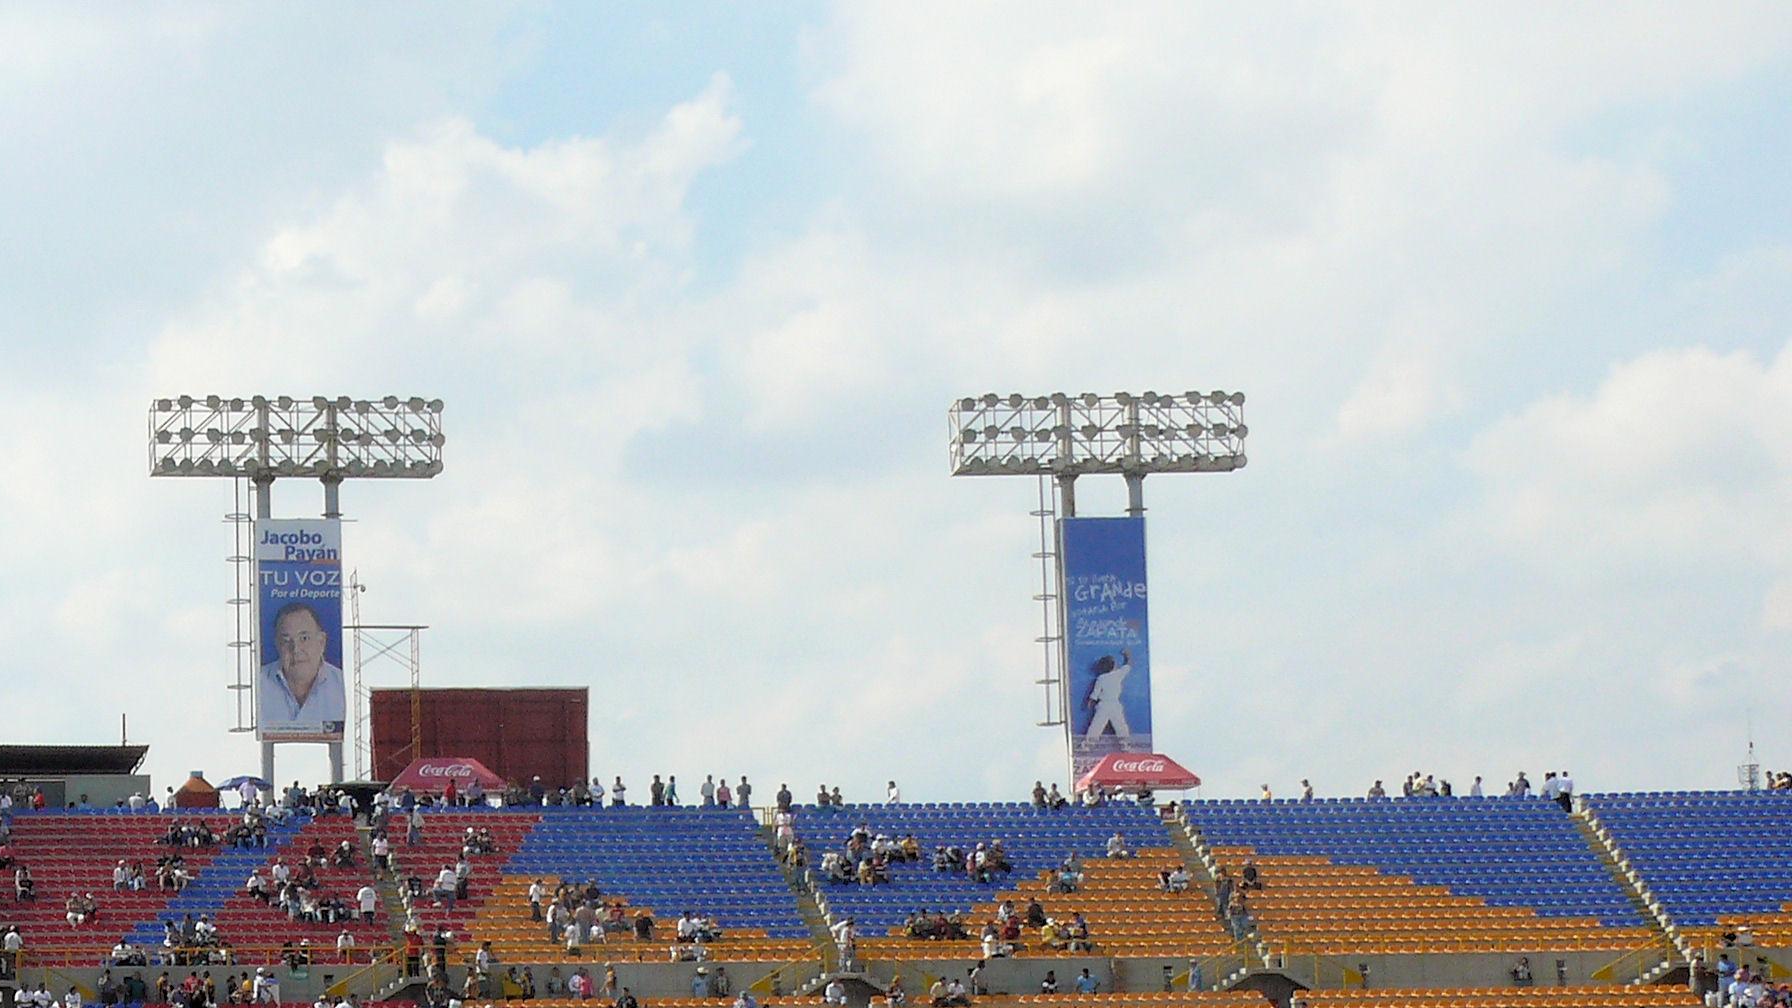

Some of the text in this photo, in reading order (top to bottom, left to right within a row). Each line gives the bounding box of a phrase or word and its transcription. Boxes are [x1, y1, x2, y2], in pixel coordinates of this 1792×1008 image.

[260, 529, 322, 545] Jacobo
[259, 570, 340, 586] TU VOZ
[270, 588, 288, 598] Por
[300, 588, 340, 600] Deporte
